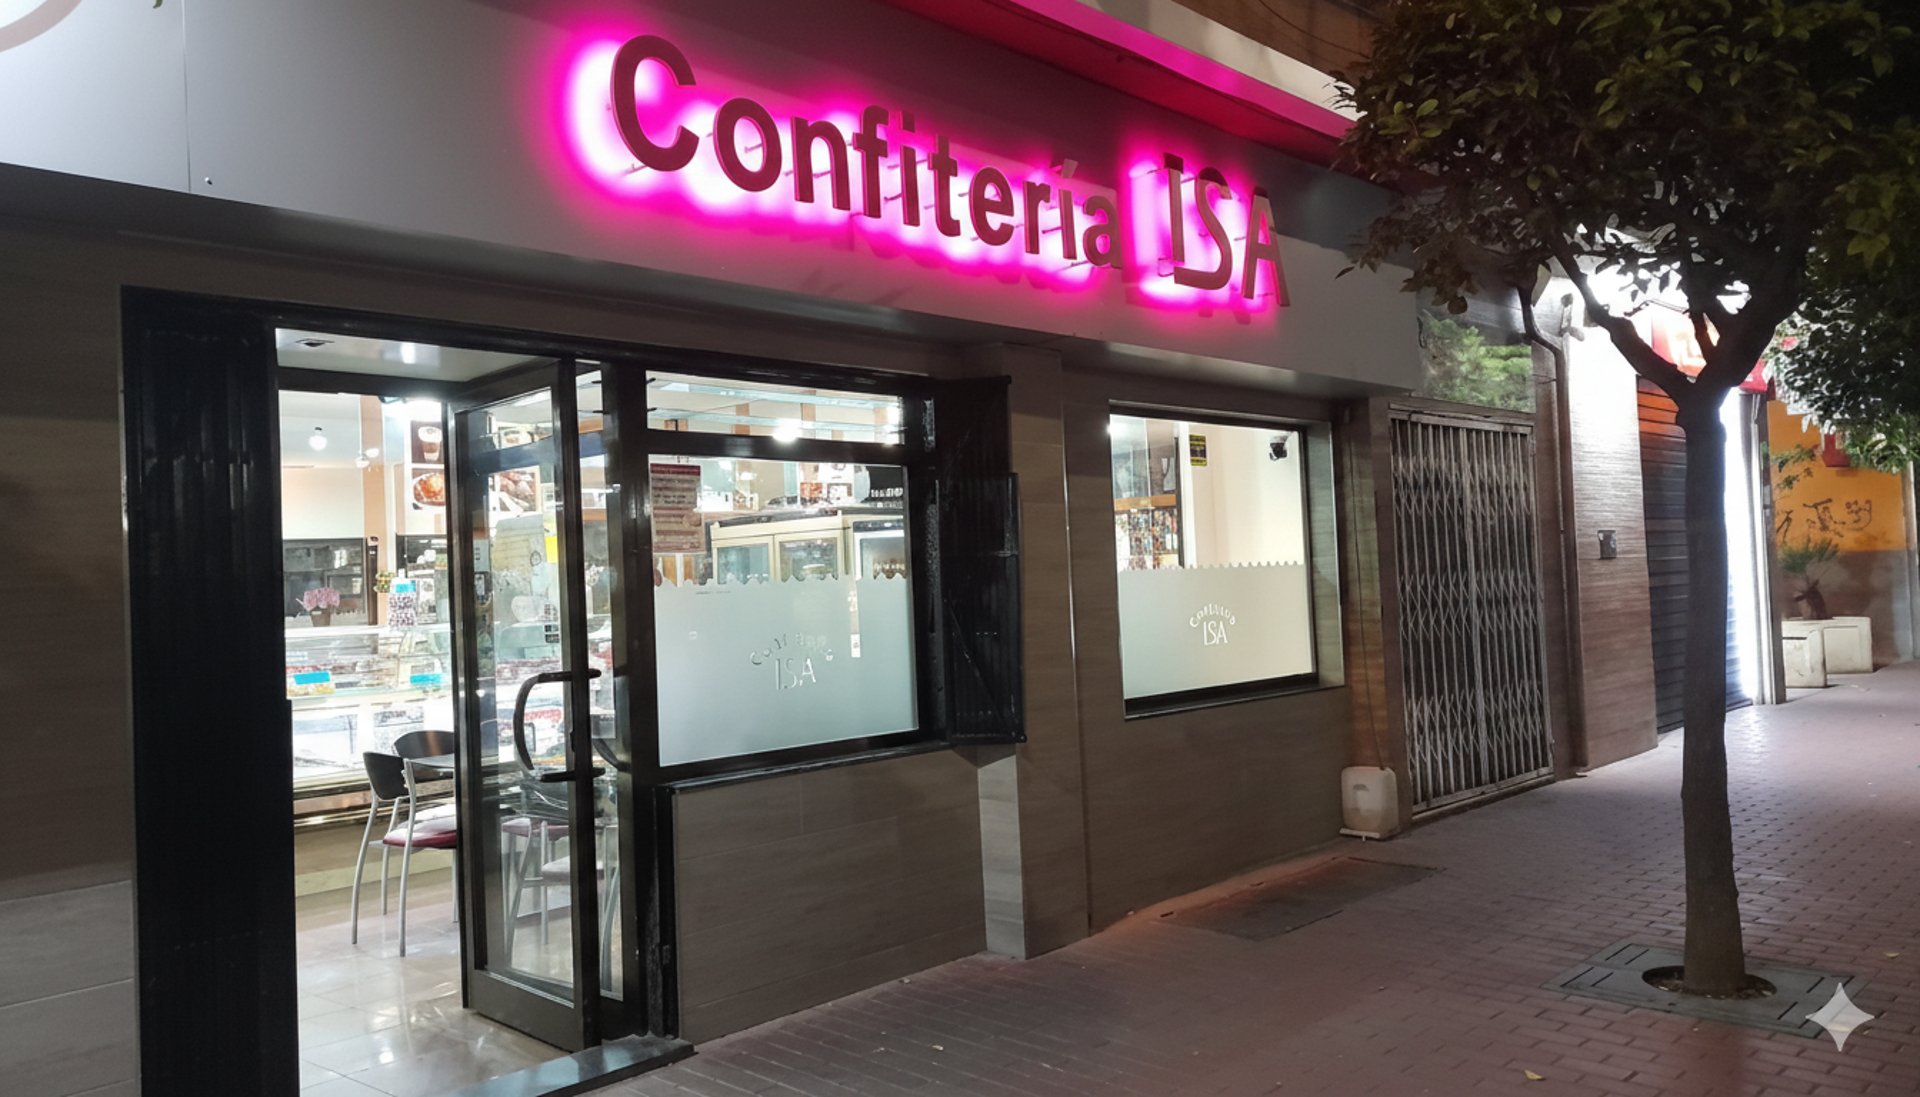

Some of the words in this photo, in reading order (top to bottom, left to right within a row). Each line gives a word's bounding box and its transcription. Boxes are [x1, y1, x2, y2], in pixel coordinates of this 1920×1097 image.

[609, 34, 1122, 270] Confitería
[1162, 152, 1291, 307] ISA
[1203, 620, 1228, 646] ISA
